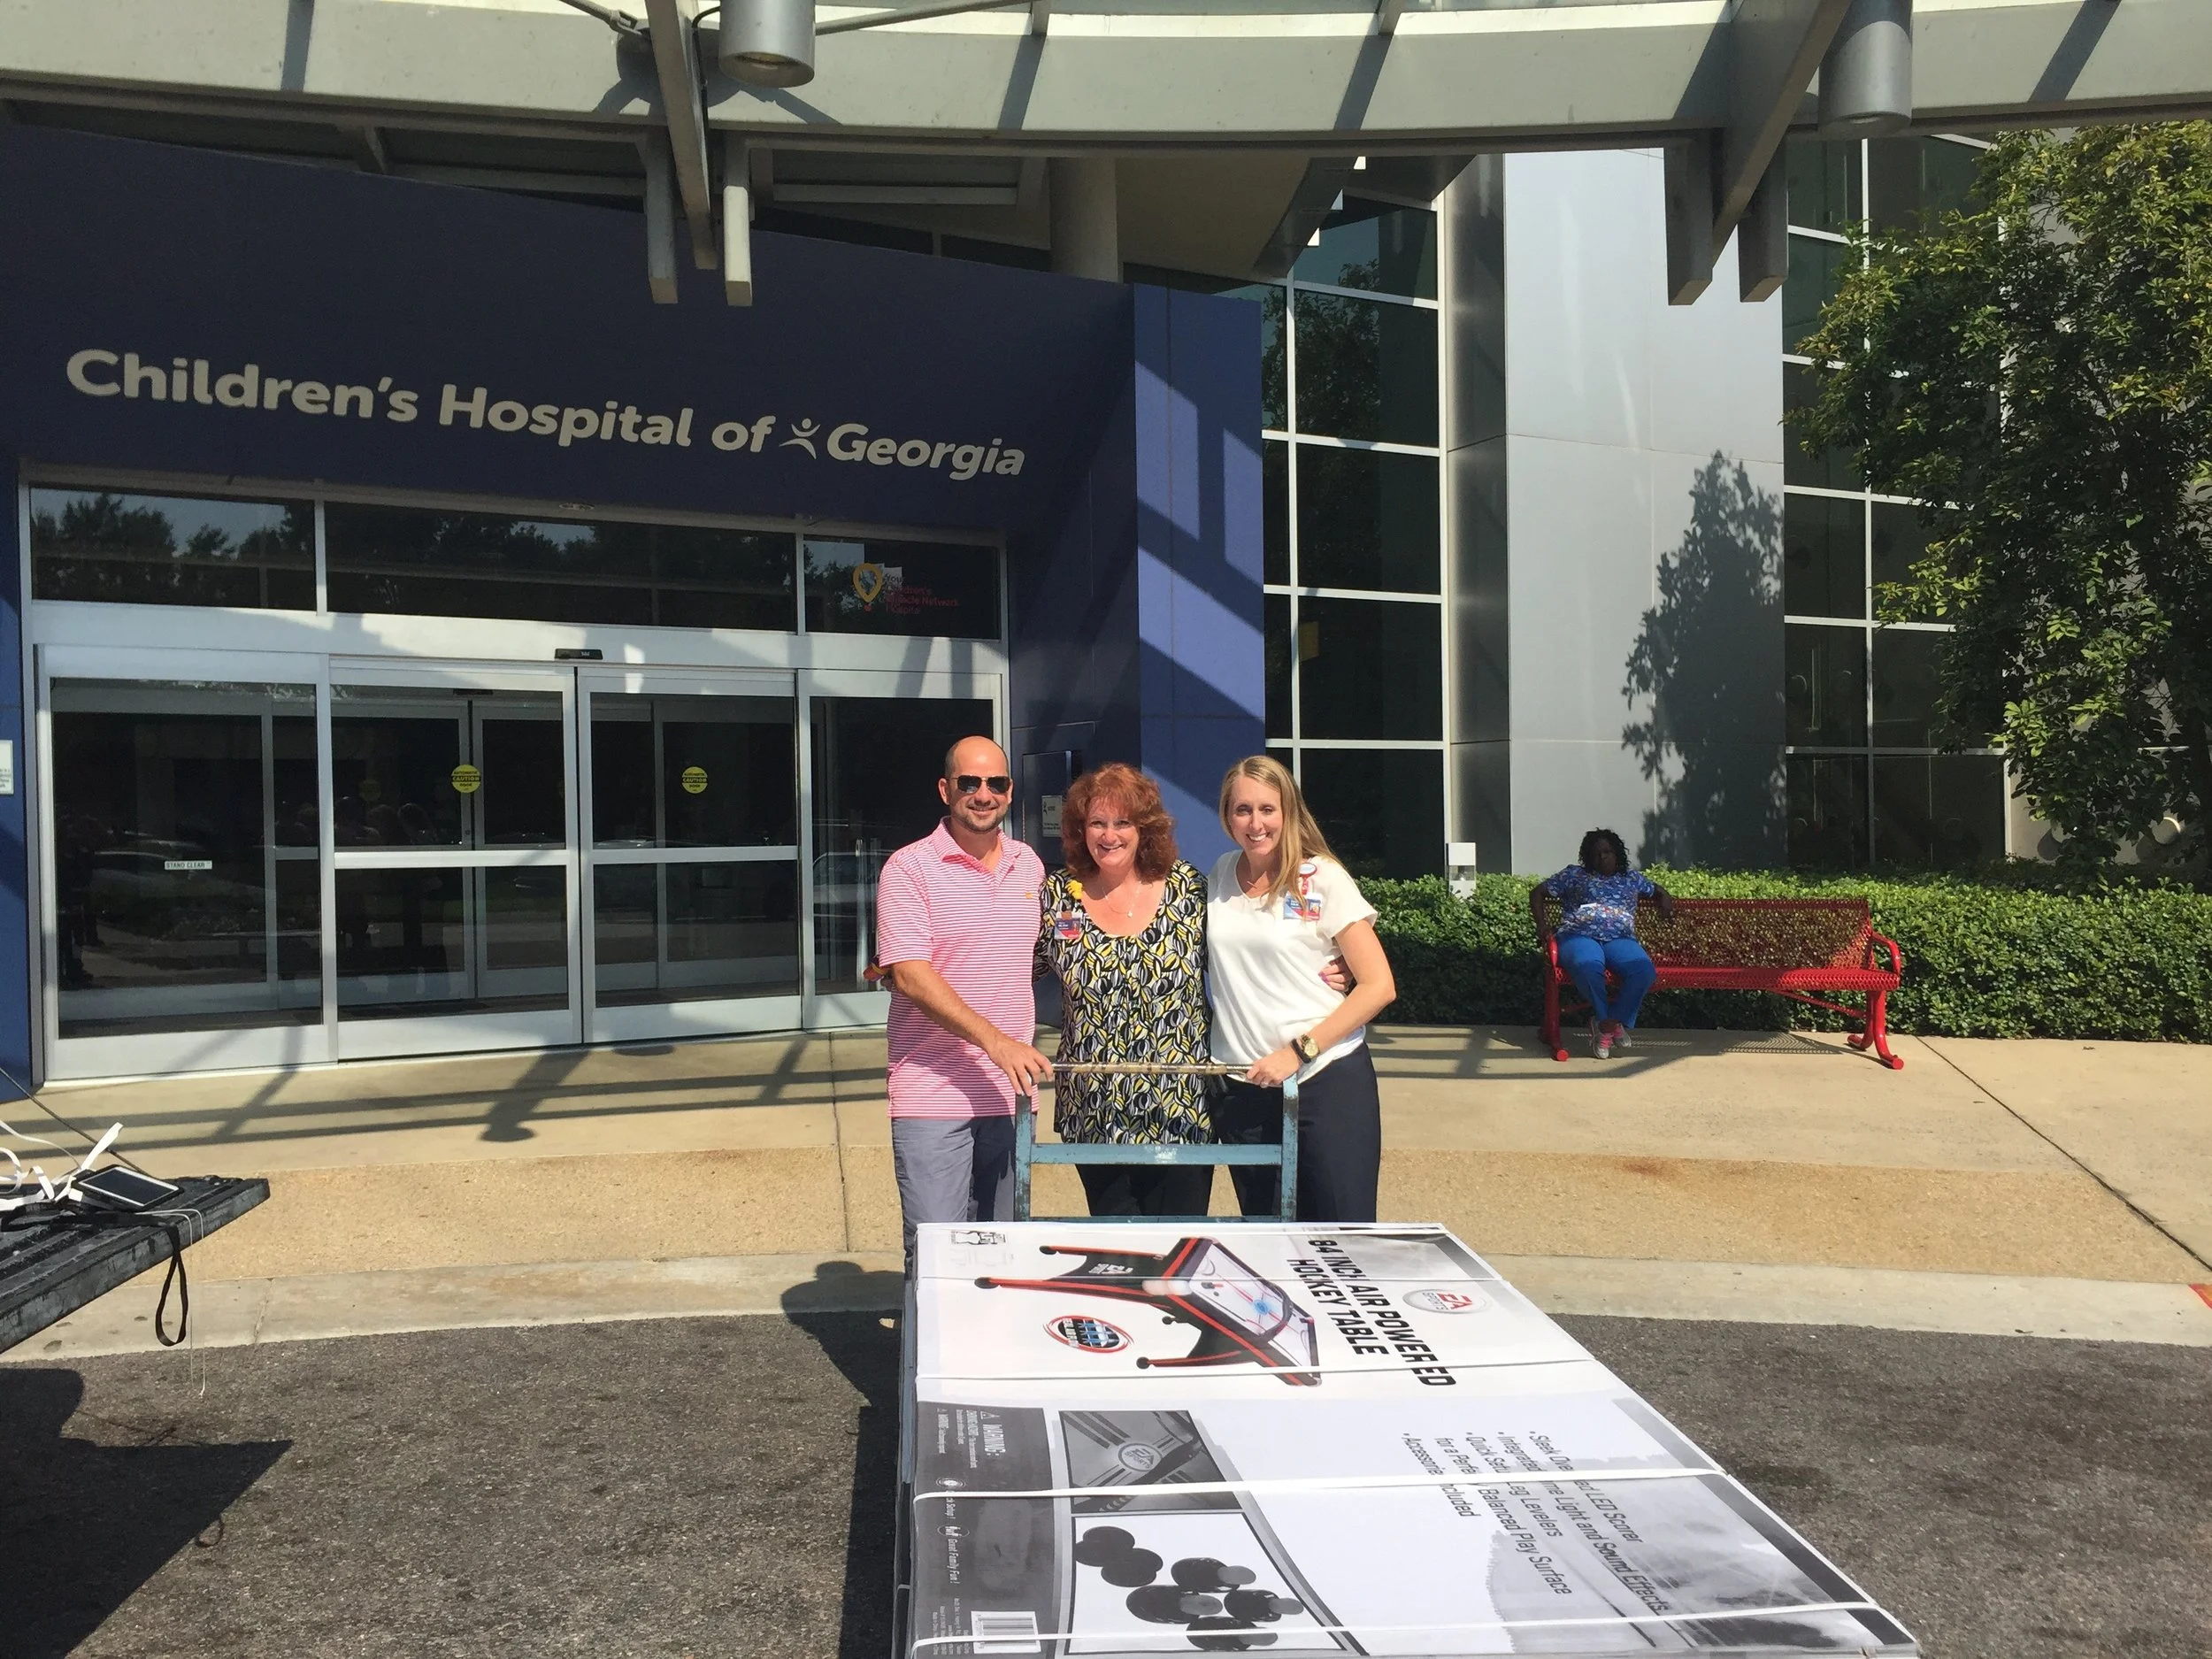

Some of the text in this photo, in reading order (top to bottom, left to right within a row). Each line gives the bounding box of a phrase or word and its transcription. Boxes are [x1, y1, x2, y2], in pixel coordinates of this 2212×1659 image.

[66, 349, 1025, 480] Children's Hospital of Georgia
[1308, 1240, 1344, 1253] 84
[1286, 1259, 1390, 1355] HOCKEY TABLE
[1346, 1284, 1391, 1307] AIR
[1366, 1310, 1457, 1386] POWERED
[1402, 1437, 1444, 1475] Accessorie
[1465, 1436, 1498, 1456] Quick
[1520, 1498, 1563, 1537] Levelers
[1529, 1435, 1562, 1455] Sleek
[1586, 1493, 1618, 1511] LED
[1602, 1512, 1644, 1543] Scorer
[947, 1552, 960, 1570] Family
[1434, 1437, 1455, 1448] for
[1478, 1488, 1528, 1531] Balanced
[1509, 1532, 1540, 1554] Play
[1528, 1555, 1573, 1595] Surface
[1497, 1436, 1550, 1472] Integrated
[1555, 1497, 1592, 1521] Light
[1576, 1523, 1609, 1540] and
[1593, 1542, 1640, 1573] Sound
[1622, 1575, 1670, 1611] Effects
